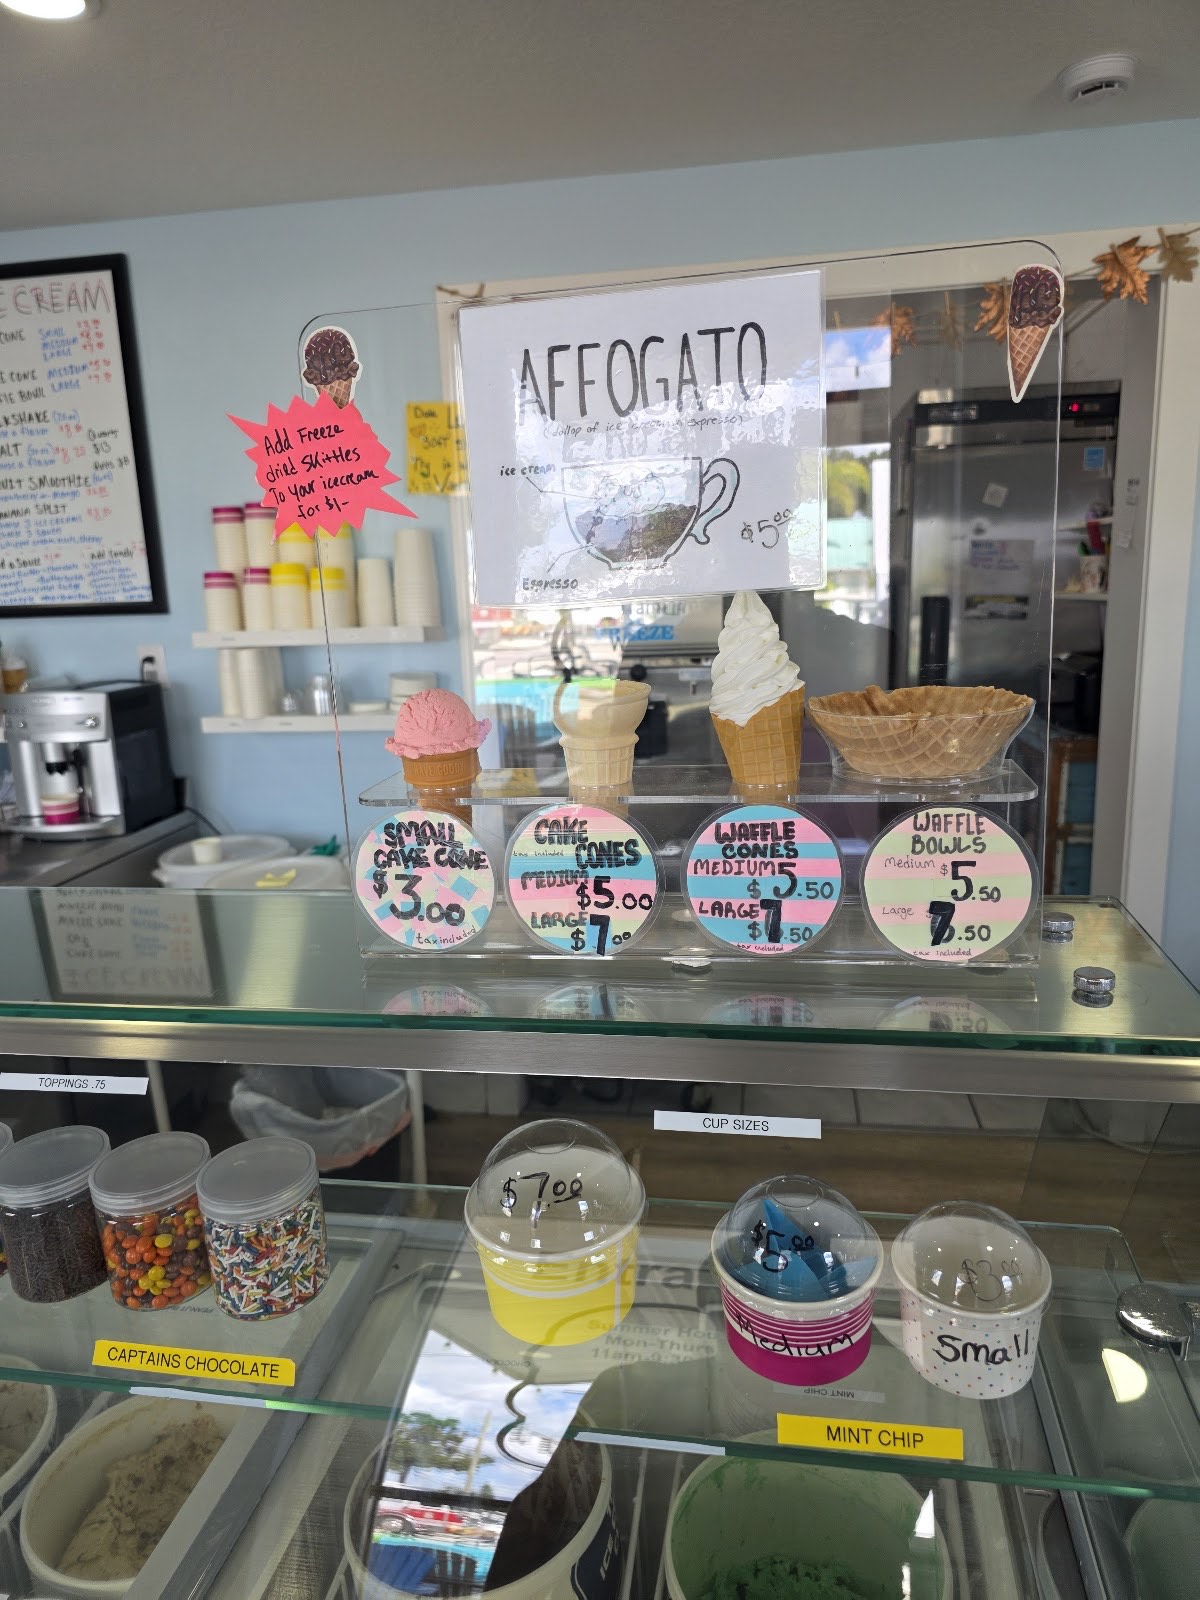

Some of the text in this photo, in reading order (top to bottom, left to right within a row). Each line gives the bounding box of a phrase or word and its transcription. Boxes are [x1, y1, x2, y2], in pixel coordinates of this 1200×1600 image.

[13, 278, 111, 315] CREAM
[519, 321, 768, 426] AFFOGATO
[586, 421, 600, 433] of
[264, 424, 345, 457] Add Freeze
[266, 456, 299, 483] dried
[499, 465, 517, 477] ice
[269, 487, 286, 506] To
[534, 816, 589, 845] CAKE
[714, 820, 796, 845] WAFFLE
[912, 811, 986, 836] WAFFLE
[384, 820, 463, 850] SMALL
[911, 834, 987, 856] BOWLS
[374, 848, 489, 871] CAKE CONE
[575, 839, 642, 870] CONES
[721, 841, 799, 860] CONES
[693, 859, 776, 877] MEDIUM
[884, 855, 936, 869] Medium
[521, 869, 590, 891] MEDIUM
[373, 869, 466, 927] $3.00
[575, 875, 653, 911] $5.00
[530, 911, 589, 929] LARGE
[698, 900, 760, 919] LARGE
[882, 906, 915, 920] Large
[416, 932, 438, 945] tax
[936, 948, 973, 958] included
[39, 1077, 106, 1090] TOPPINGS .75
[702, 1117, 769, 1132] CUP SIZES
[736, 1311, 854, 1357] Medium
[933, 1328, 1029, 1365] Small
[107, 1346, 280, 1379] CAPTAINS CHOCOLATE
[804, 1387, 855, 1399] MINT CHIP
[826, 1425, 924, 1449] MINT CHIP
